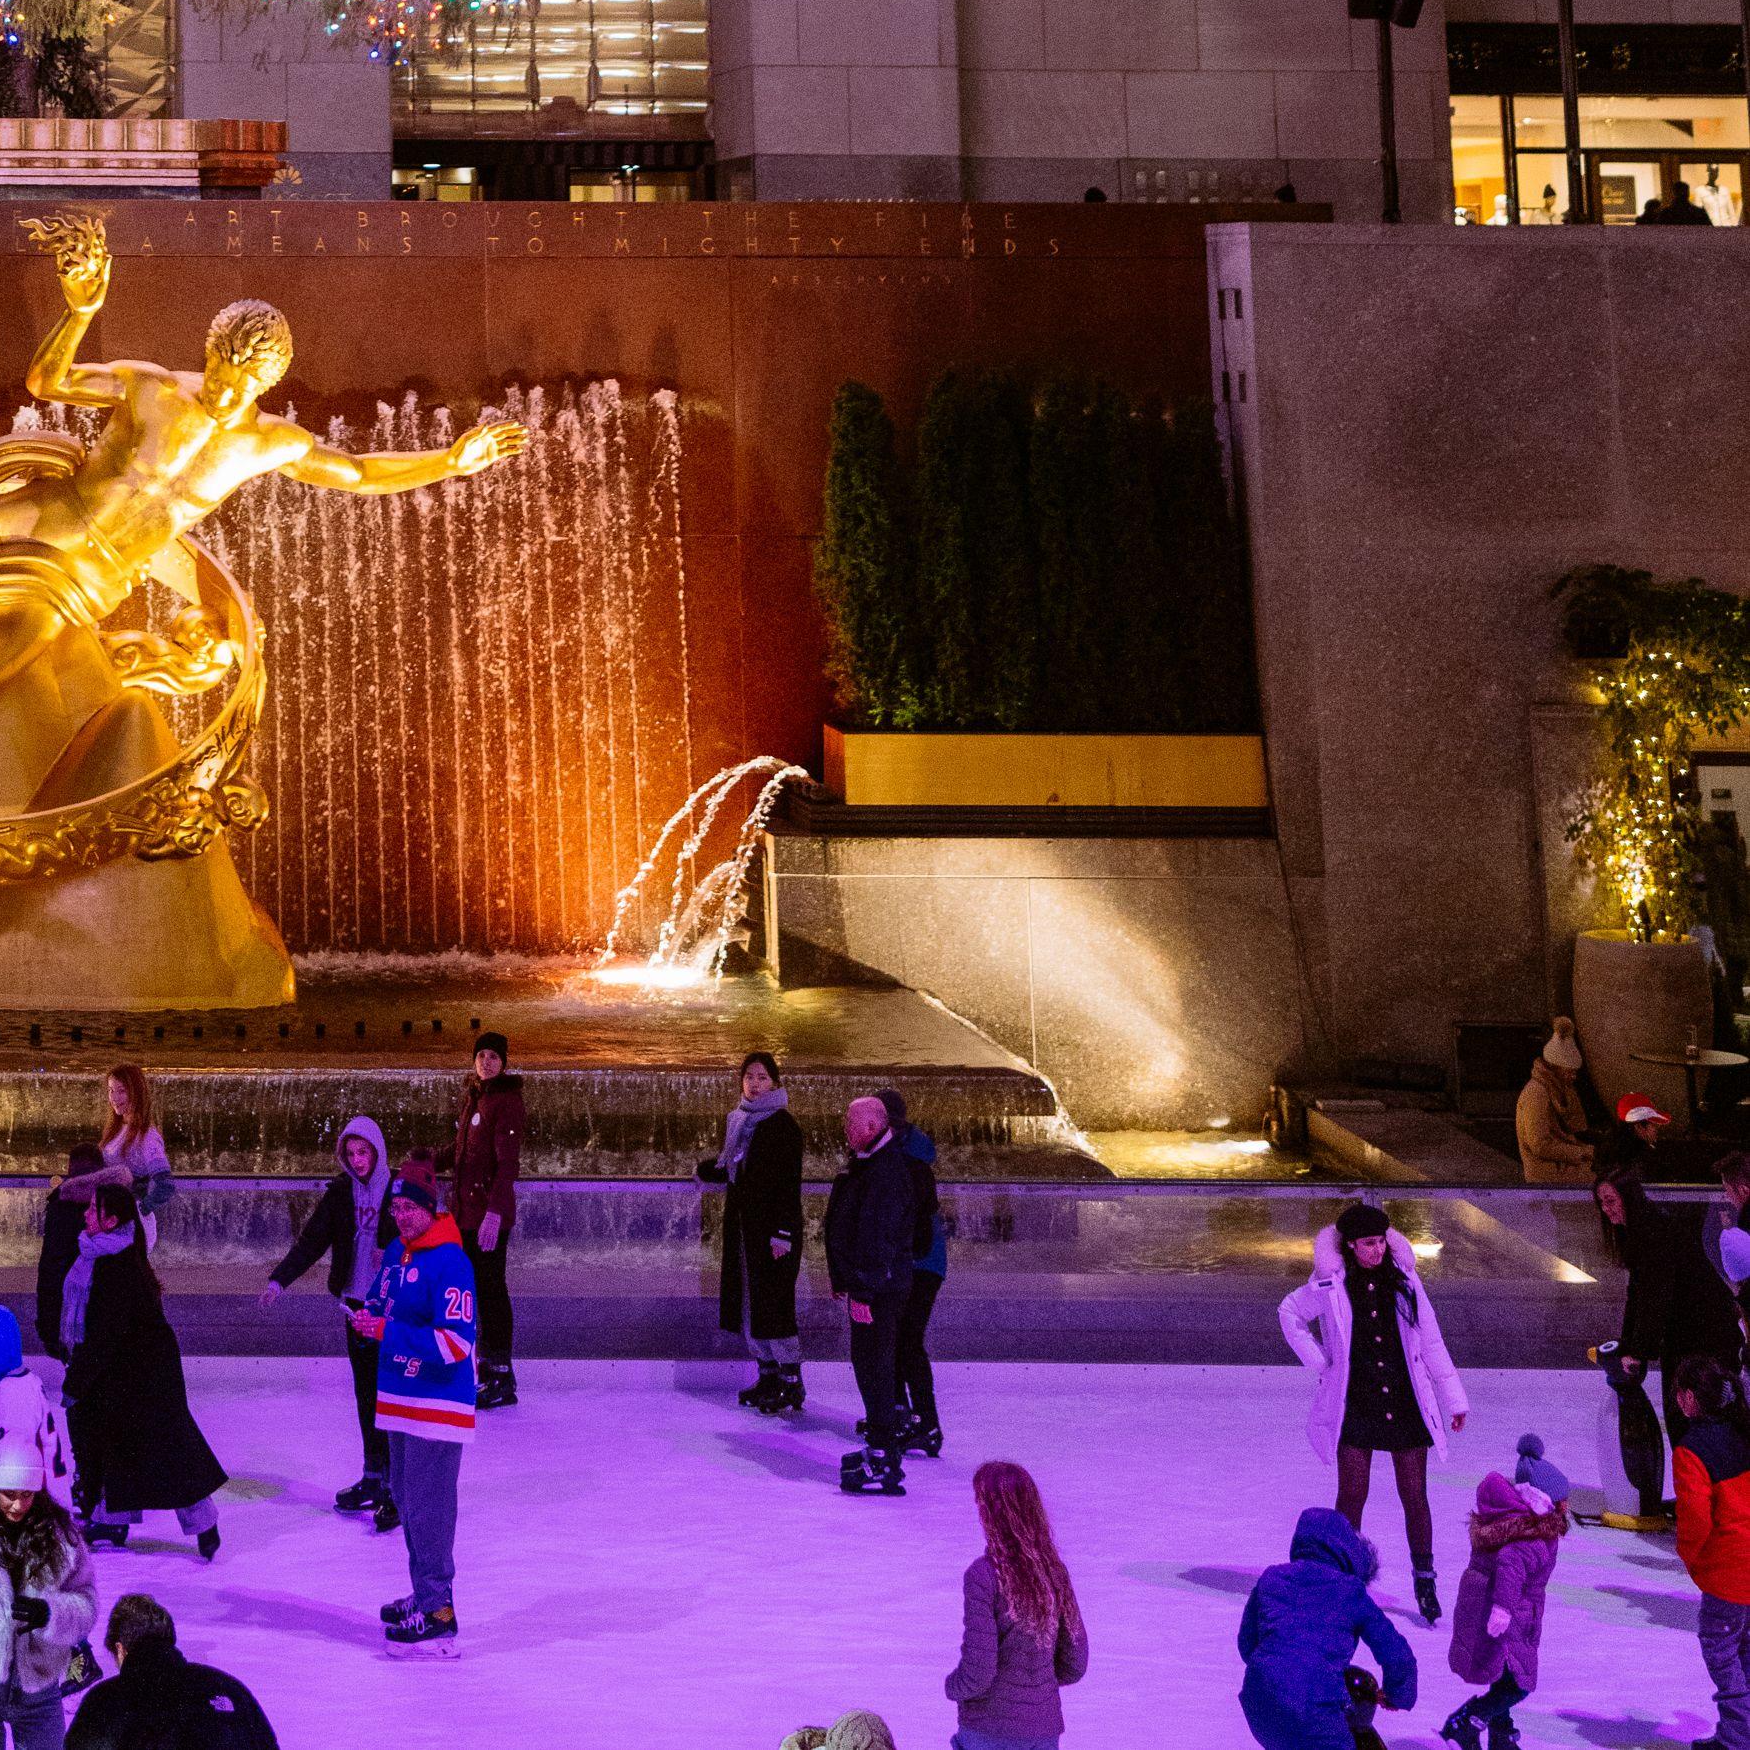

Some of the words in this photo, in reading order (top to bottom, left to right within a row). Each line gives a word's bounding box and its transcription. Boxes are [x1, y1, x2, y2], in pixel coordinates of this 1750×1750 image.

[184, 210, 284, 228] ART
[358, 210, 629, 229] BROUGHT
[702, 211, 801, 228] THE
[875, 212, 1017, 229] FIRE
[140, 236, 156, 253] A
[225, 237, 413, 255] MEANS
[487, 237, 546, 254] TO
[613, 237, 845, 255] MIGHTY
[920, 238, 1061, 255] ENDS
[444, 1286, 474, 1324] 20
